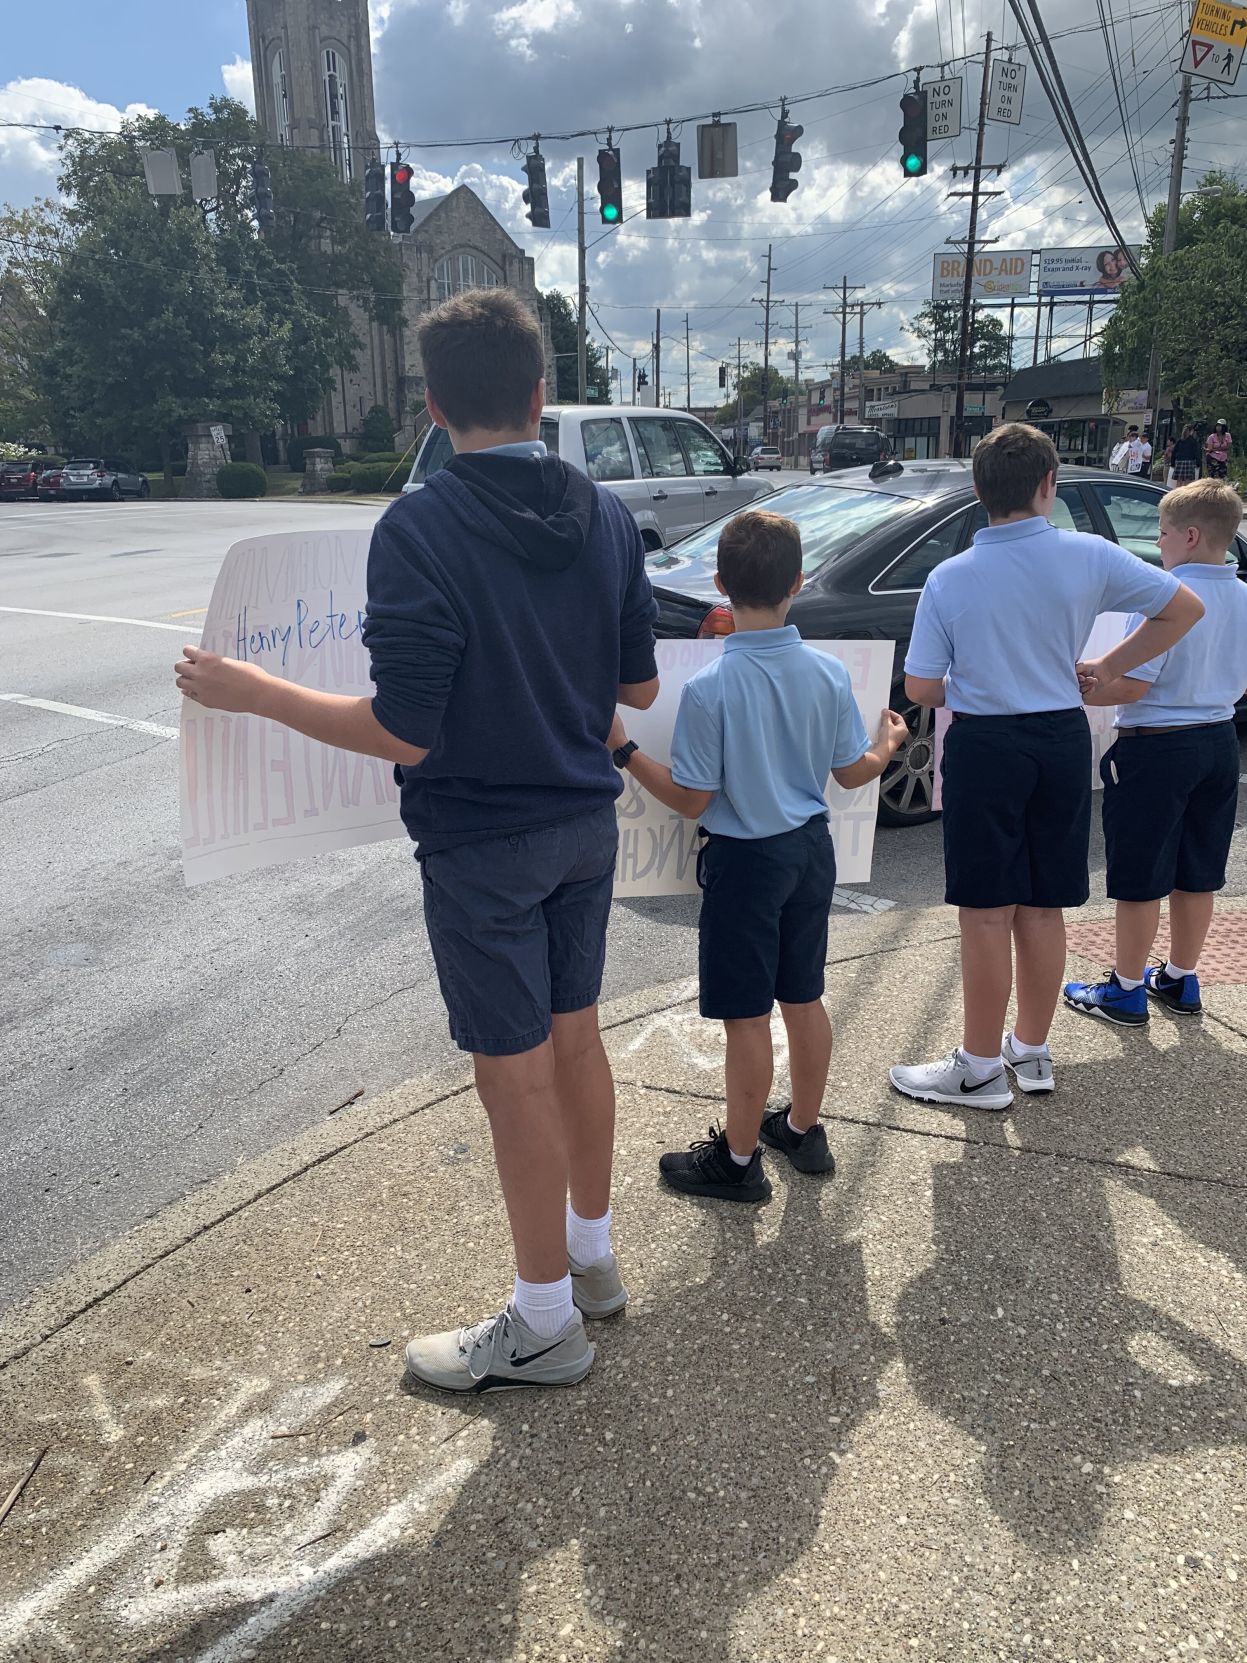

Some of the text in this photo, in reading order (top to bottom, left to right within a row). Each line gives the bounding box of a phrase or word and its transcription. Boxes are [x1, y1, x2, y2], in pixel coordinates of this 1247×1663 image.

[1200, 2, 1232, 21] TURNING
[1196, 17, 1229, 36] VEHICLES
[1211, 53, 1220, 63] TO
[1001, 66, 1017, 80] NO
[932, 84, 951, 98] NO
[998, 80, 1018, 93] TURN
[929, 98, 953, 110] TURN
[1000, 95, 1012, 105] ON
[934, 112, 948, 123] ON
[997, 107, 1012, 118] RED
[932, 124, 950, 135] RED
[1062, 264, 1074, 272] and
[1075, 264, 1092, 272] X-ray
